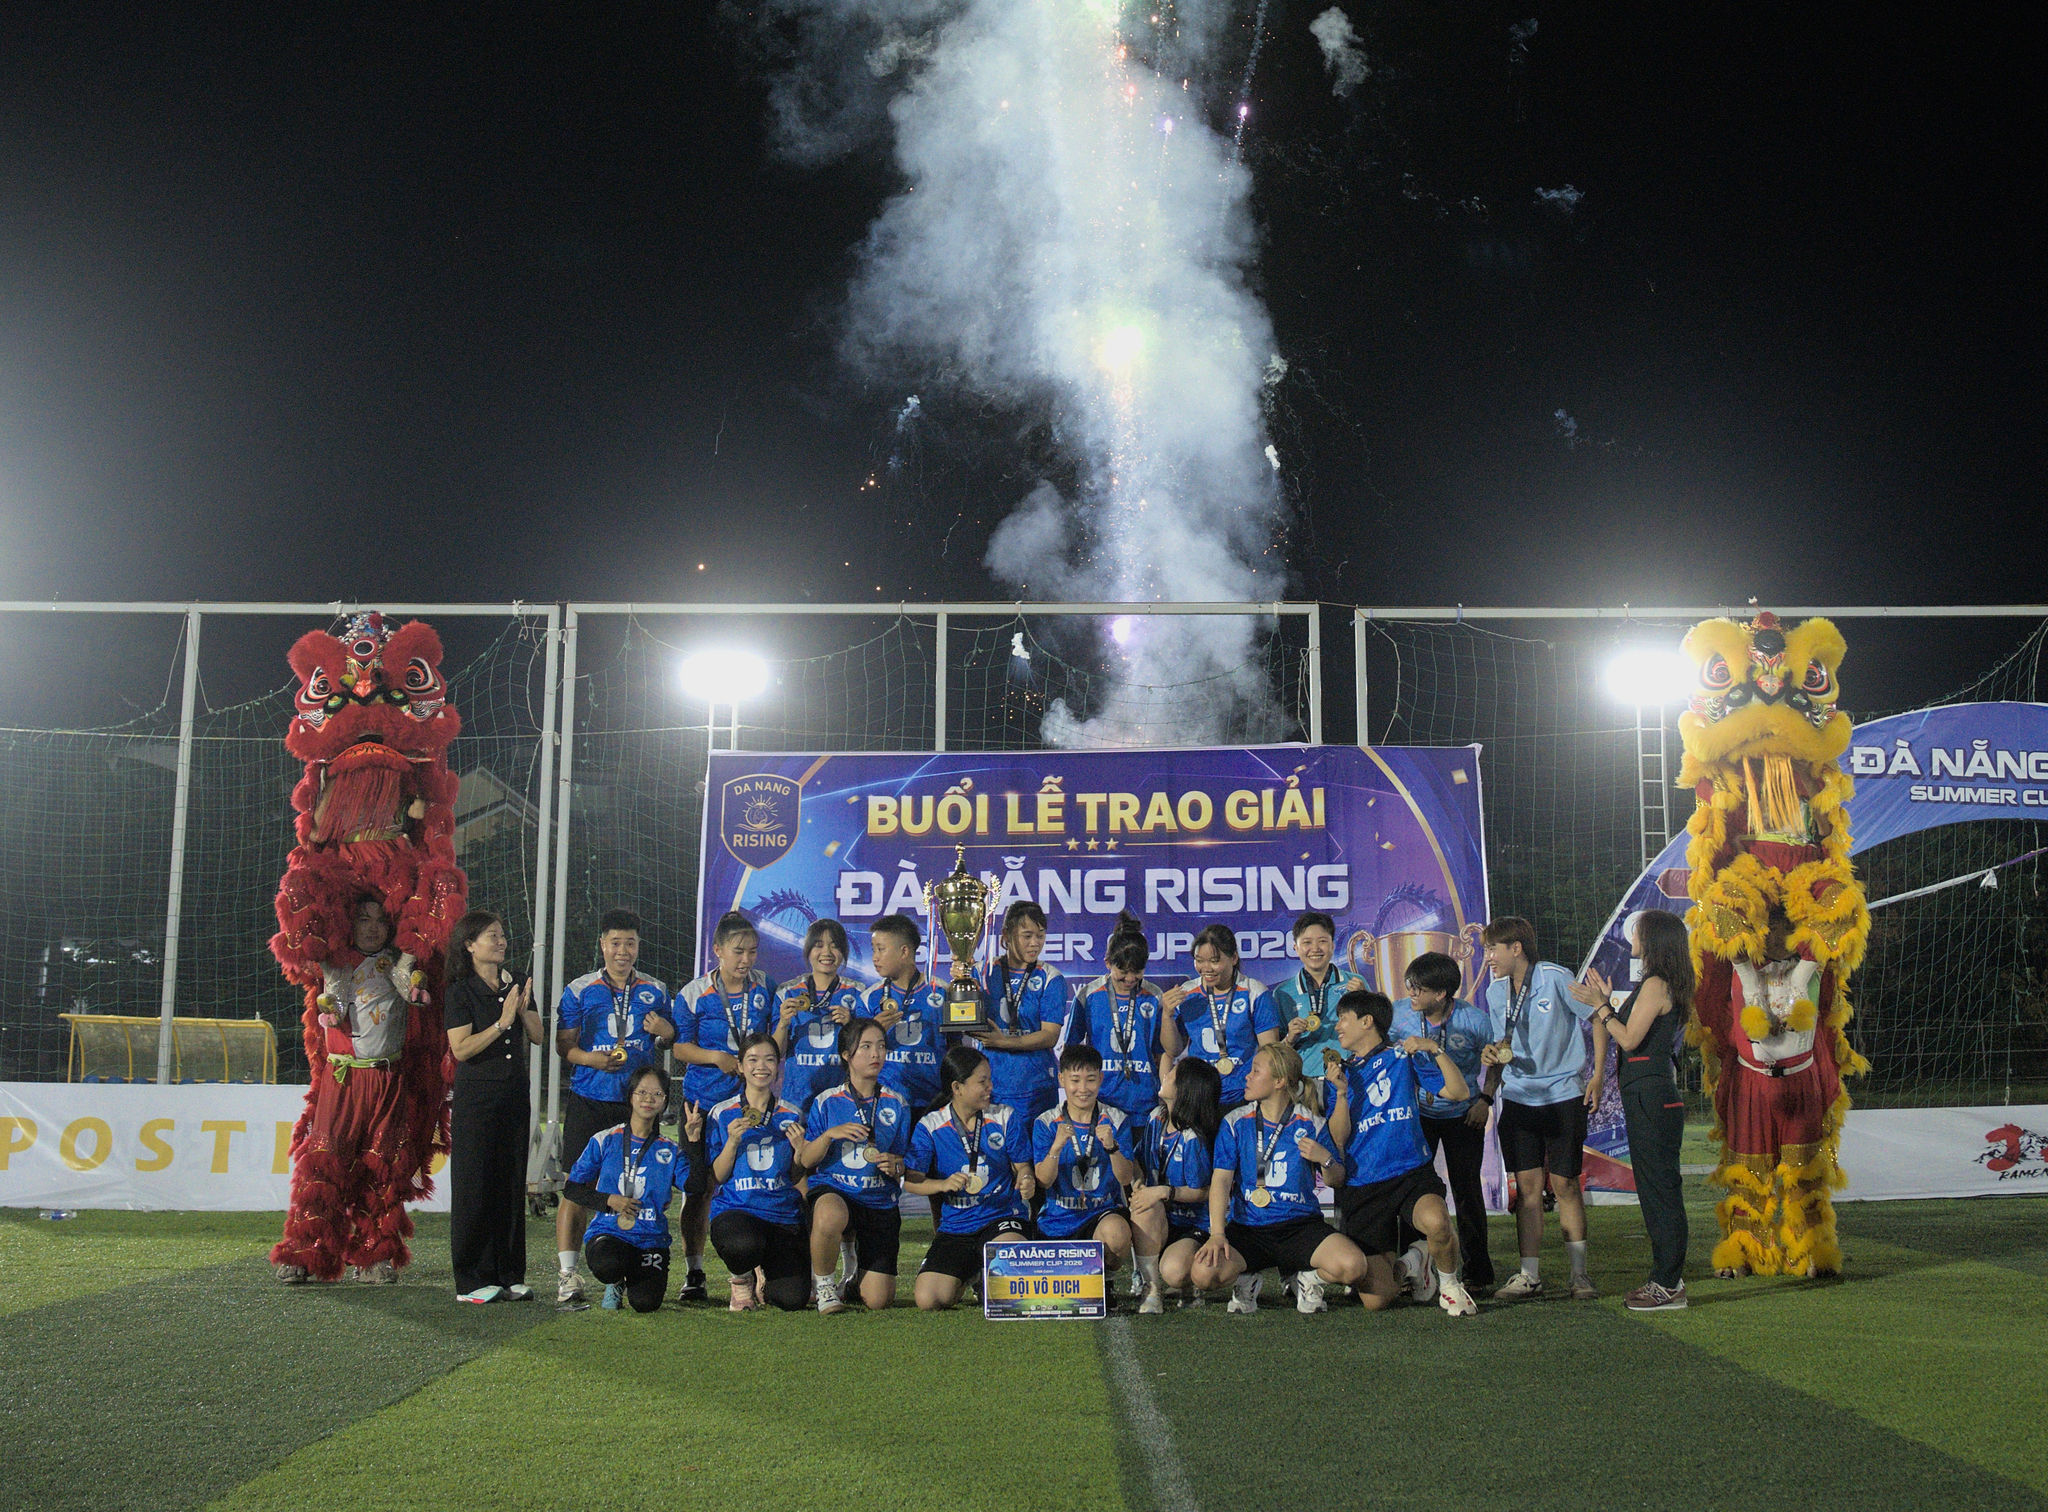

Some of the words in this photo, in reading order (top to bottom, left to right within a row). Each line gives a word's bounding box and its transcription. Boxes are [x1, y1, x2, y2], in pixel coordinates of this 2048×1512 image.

[1850, 739, 1922, 775] ĐÀ
[733, 783, 752, 796] DA
[755, 781, 791, 796] NANG
[1910, 785, 2018, 806] SUMMER
[867, 777, 989, 836] BUỔI
[1007, 776, 1066, 834] LỄ
[1076, 791, 1213, 833] TRAO
[1224, 776, 1326, 831] GIẢI
[732, 833, 788, 847] RISING
[836, 858, 929, 916] ĐÀ
[949, 856, 1126, 916] ẴNG
[1145, 863, 1349, 914] RISING
[915, 1051, 936, 1064] TEA
[1102, 1059, 1123, 1071] ILK
[1387, 1106, 1413, 1122] TEA
[735, 1177, 766, 1192] MILK
[861, 1175, 886, 1189] TEA
[997, 1221, 1023, 1231] 20
[999, 1248, 1017, 1259] ĐÀ
[1058, 1248, 1097, 1258] RISING
[1009, 1277, 1029, 1297] ĐỘI
[1033, 1276, 1048, 1294] VÔ
[1053, 1279, 1080, 1297] ĐỊCH
